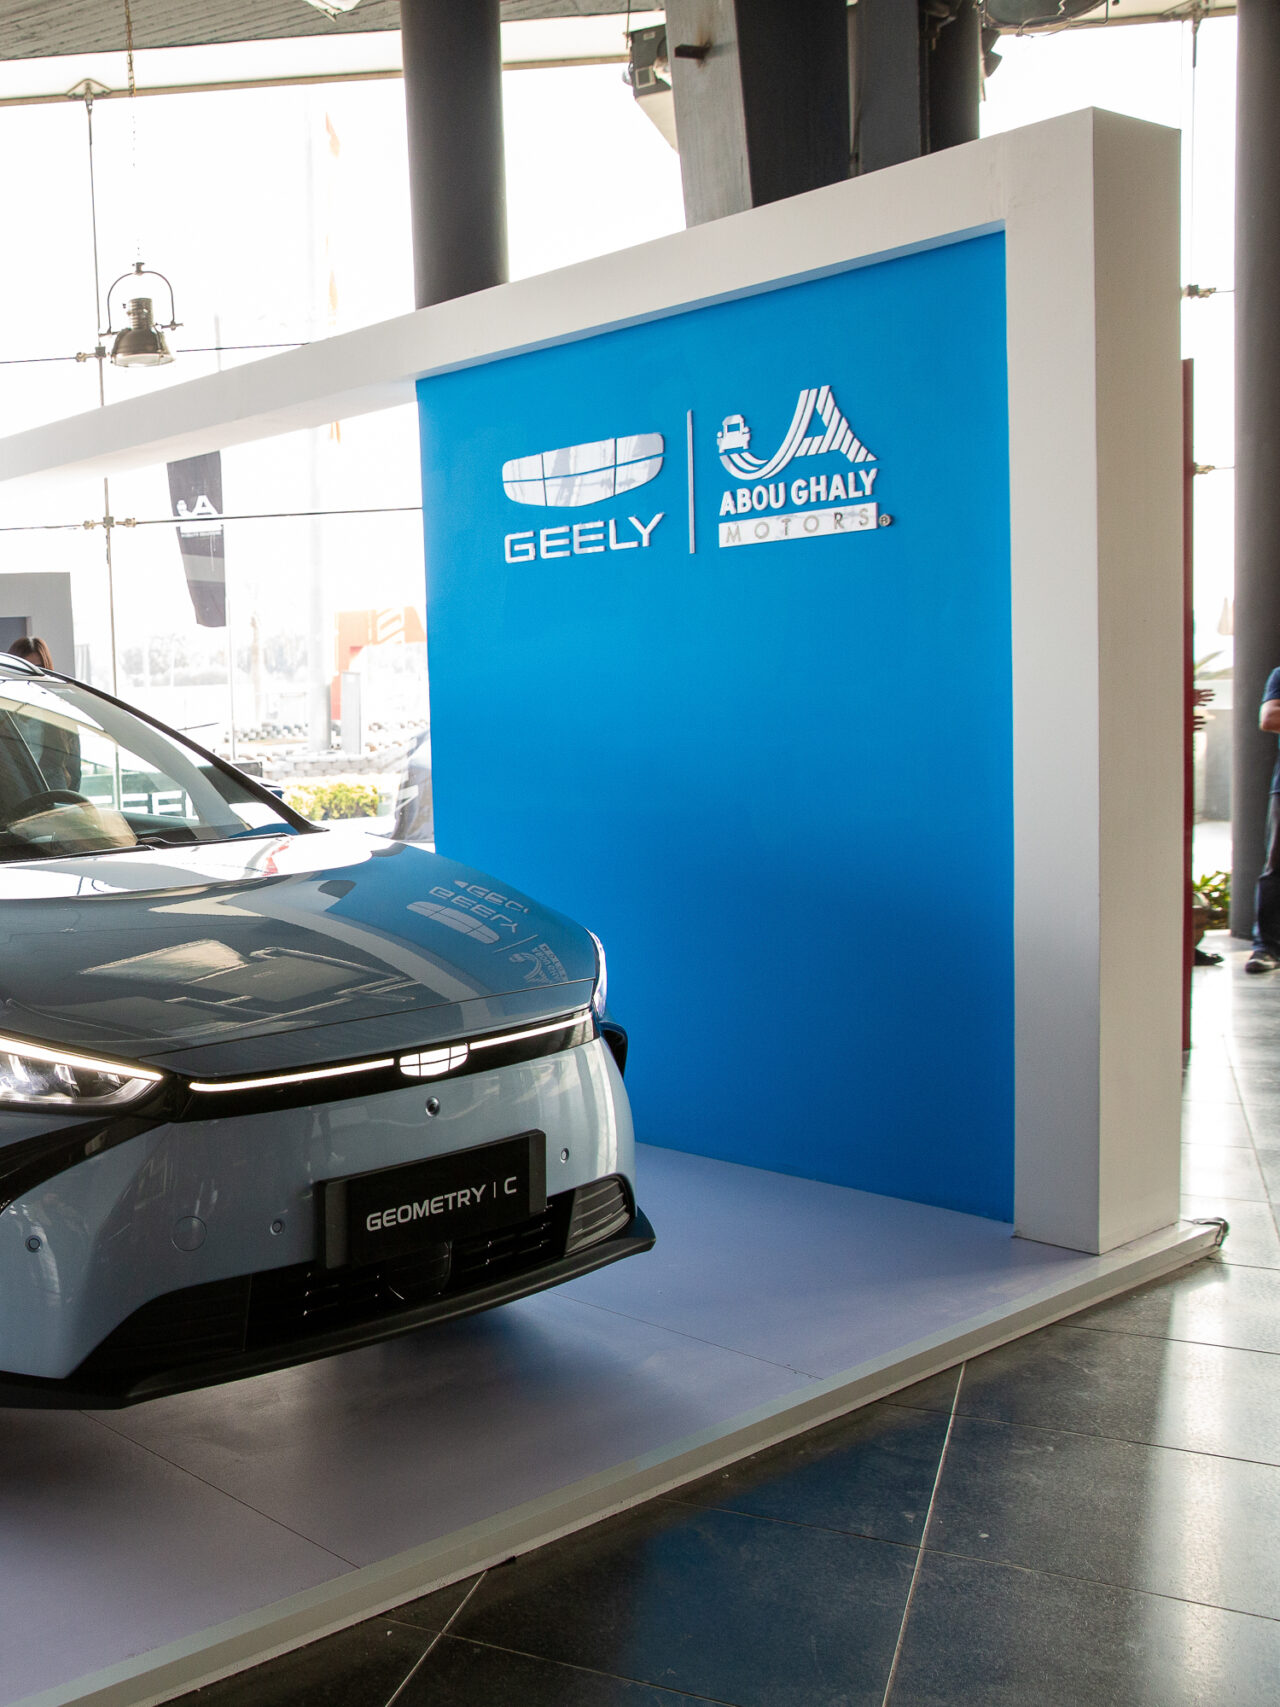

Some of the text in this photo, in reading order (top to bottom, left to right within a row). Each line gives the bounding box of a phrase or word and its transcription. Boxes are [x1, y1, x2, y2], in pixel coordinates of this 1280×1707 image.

[719, 468, 878, 516] ABOU GHALY
[504, 512, 665, 564] GEELY
[725, 507, 871, 544] MOTORS
[366, 1176, 518, 1232] GEOMETRY C
